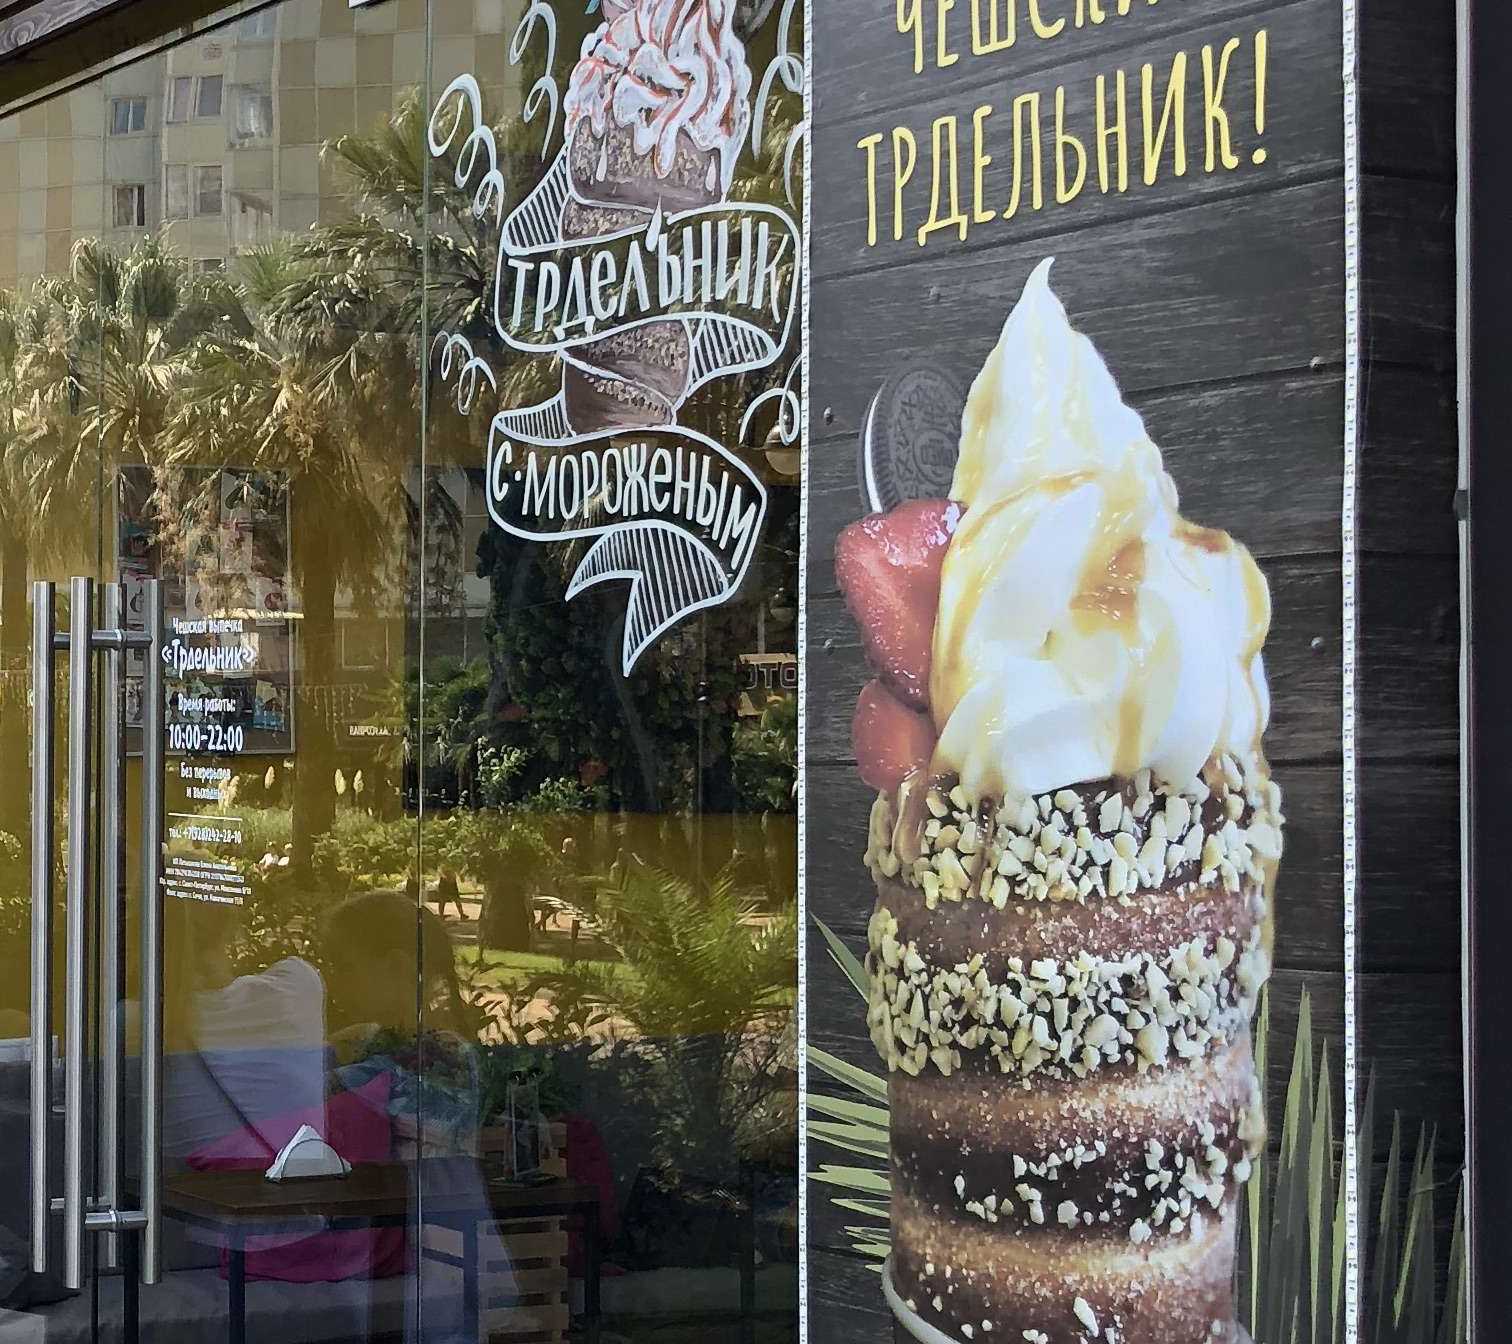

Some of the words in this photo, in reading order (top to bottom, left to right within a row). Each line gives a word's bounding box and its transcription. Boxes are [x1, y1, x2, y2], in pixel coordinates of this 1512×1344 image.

[856, 29, 1269, 248] ТРДЕЛЬНИК!
[172, 617, 207, 634] Чешская
[161, 638, 255, 680] «Трдельник»
[177, 693, 204, 716] Время
